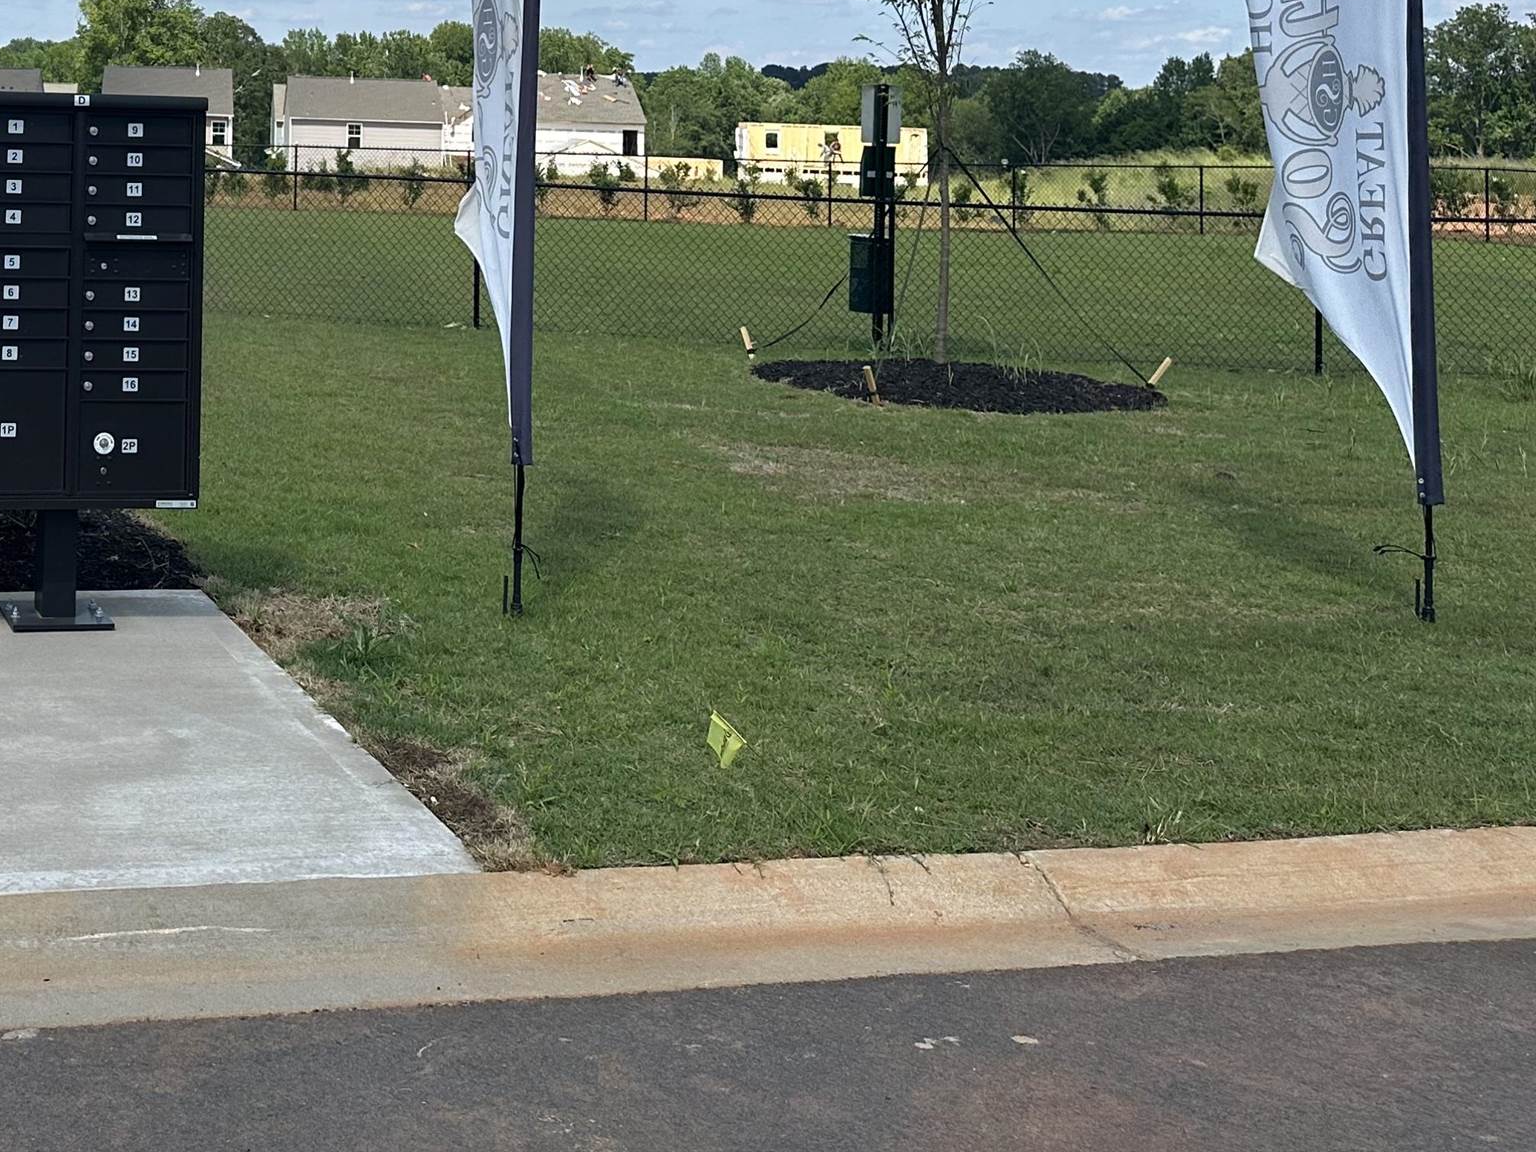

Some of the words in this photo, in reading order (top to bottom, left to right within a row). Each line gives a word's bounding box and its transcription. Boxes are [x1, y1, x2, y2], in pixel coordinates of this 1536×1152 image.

[128, 154, 141, 165] 10
[128, 184, 140, 195] 11
[127, 214, 140, 225] 12
[126, 289, 138, 300] 13
[125, 319, 138, 329] 14
[125, 349, 137, 360] 15
[124, 379, 137, 390] 16
[1, 424, 15, 435] 1P
[122, 440, 137, 451] 2P
